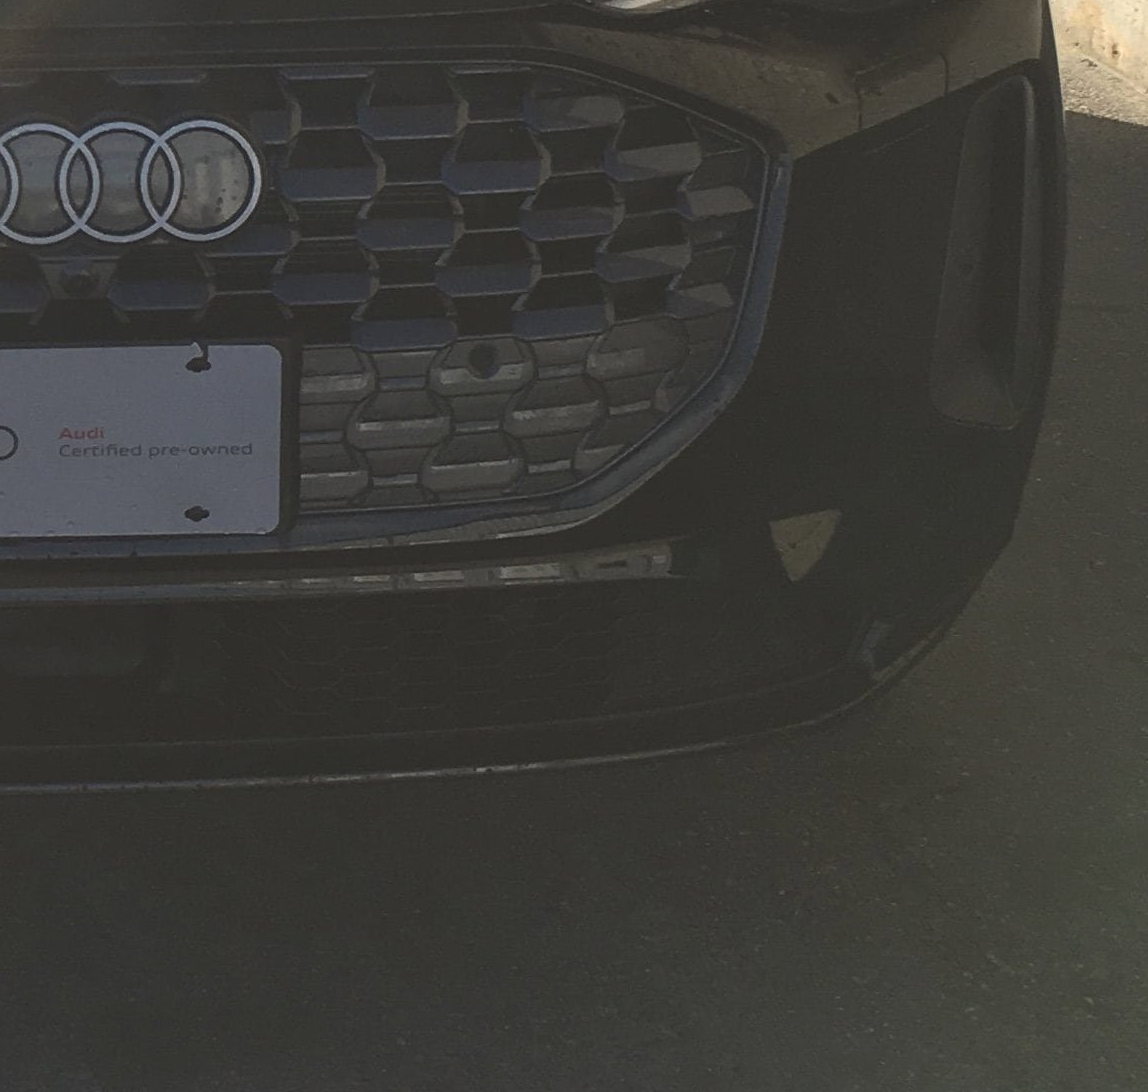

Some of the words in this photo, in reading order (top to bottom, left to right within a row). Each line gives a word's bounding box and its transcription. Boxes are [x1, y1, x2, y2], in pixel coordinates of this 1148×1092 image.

[58, 426, 105, 440] Audi
[58, 443, 142, 458] Certified
[148, 442, 254, 459] pre-owned
